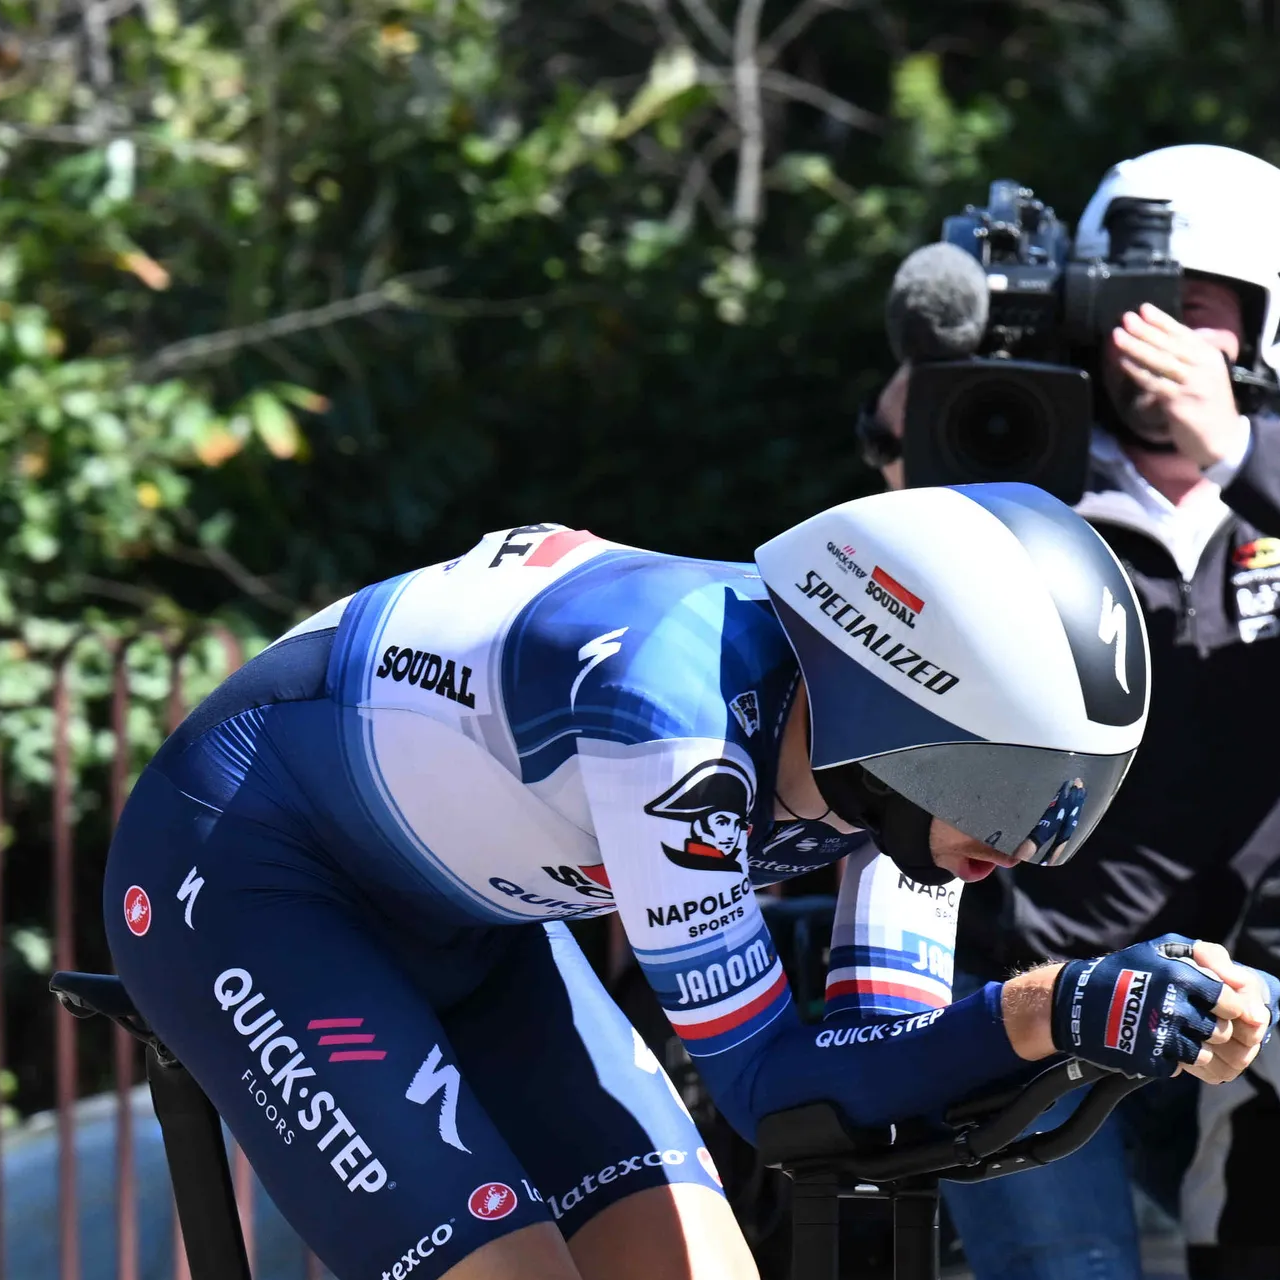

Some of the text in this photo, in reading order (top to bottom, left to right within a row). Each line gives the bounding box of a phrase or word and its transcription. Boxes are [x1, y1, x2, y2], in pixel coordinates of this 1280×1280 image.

[794, 569, 960, 696] SPECIALIZED
[865, 580, 916, 630] SOUDAL
[376, 644, 476, 709] SOUDAL
[646, 877, 751, 928] NAPOLEO
[688, 906, 745, 938] SPORTS
[675, 938, 771, 1005] JANOM
[1118, 973, 1150, 1054] SOUDAL
[240, 1068, 296, 1146] FLOORS
[545, 1148, 687, 1220] latexco
